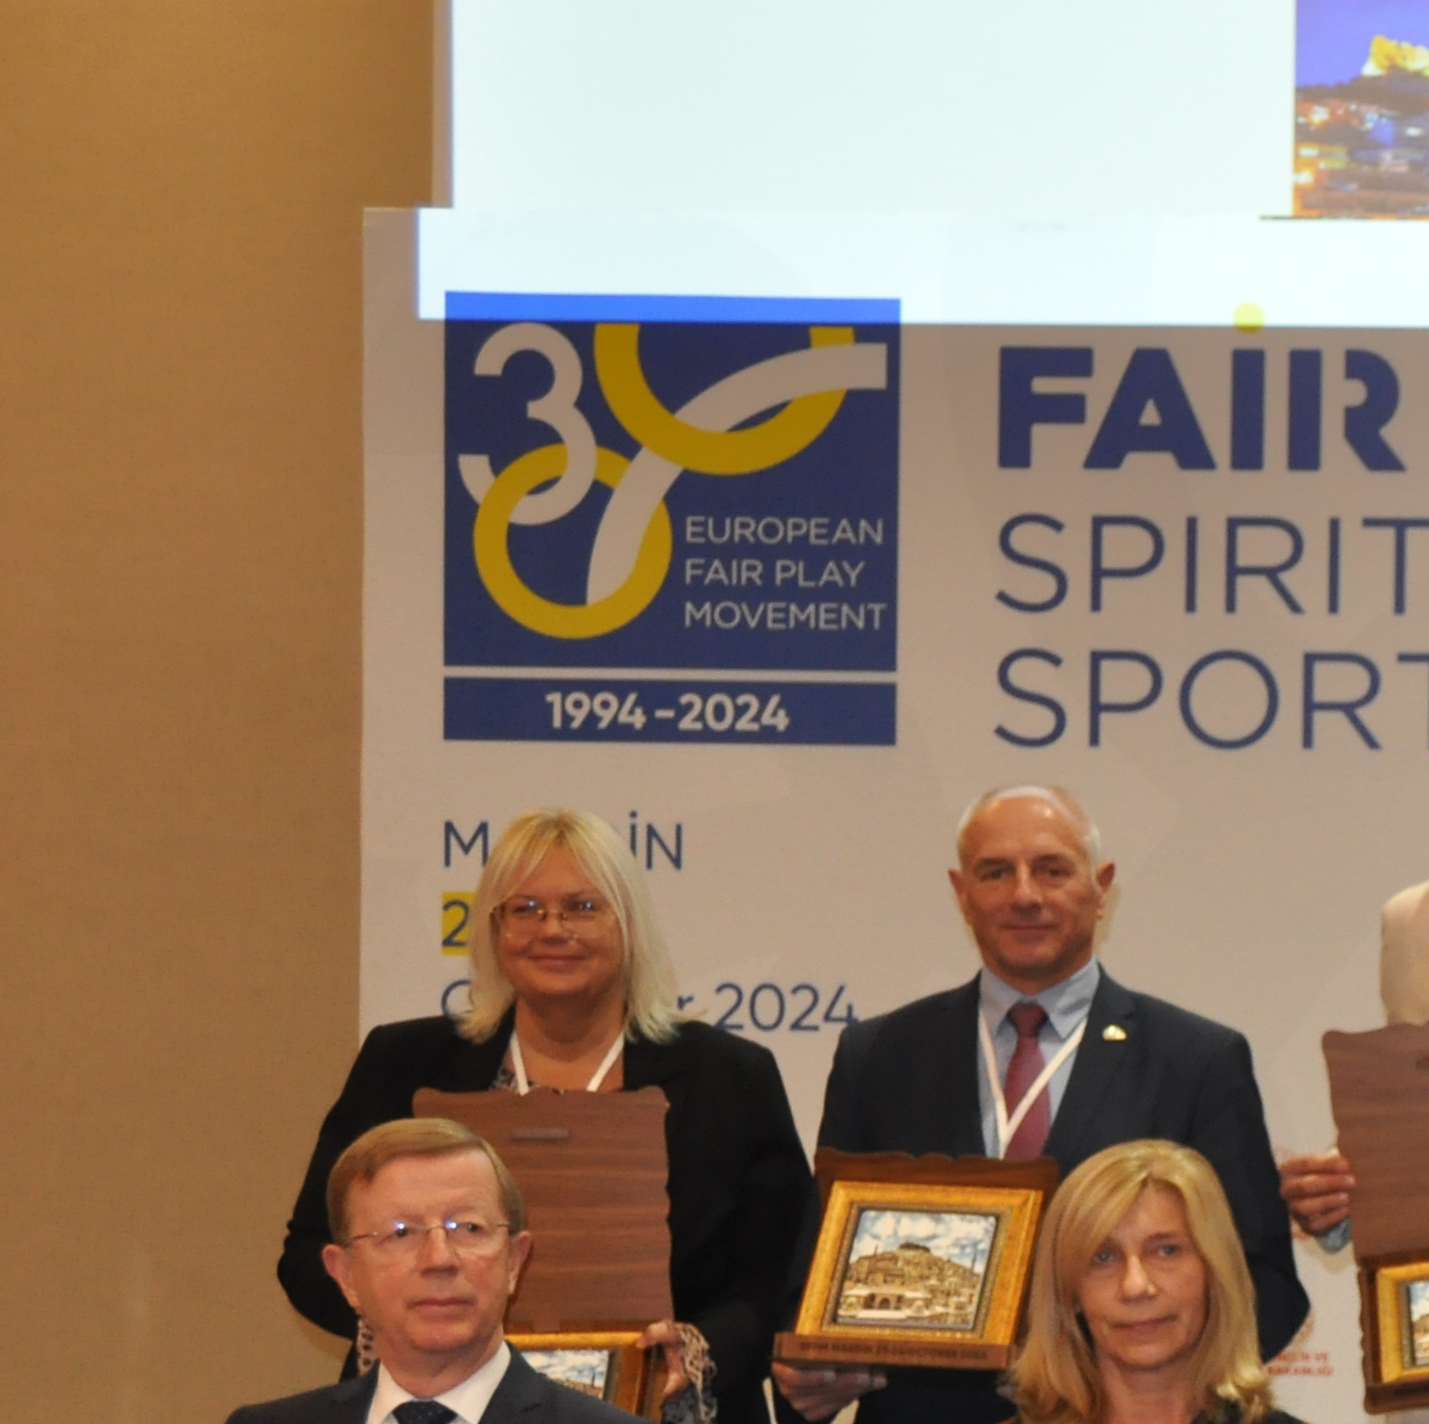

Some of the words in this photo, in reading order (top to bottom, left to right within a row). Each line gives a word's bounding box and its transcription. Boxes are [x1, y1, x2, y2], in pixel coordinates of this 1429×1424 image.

[998, 346, 1406, 473] FAIR
[685, 515, 884, 546] EUROPEAN
[685, 558, 763, 587] FAIR
[775, 559, 865, 588] PLAY
[684, 601, 887, 631] MOVEMENT
[714, 982, 859, 1033] 2024
